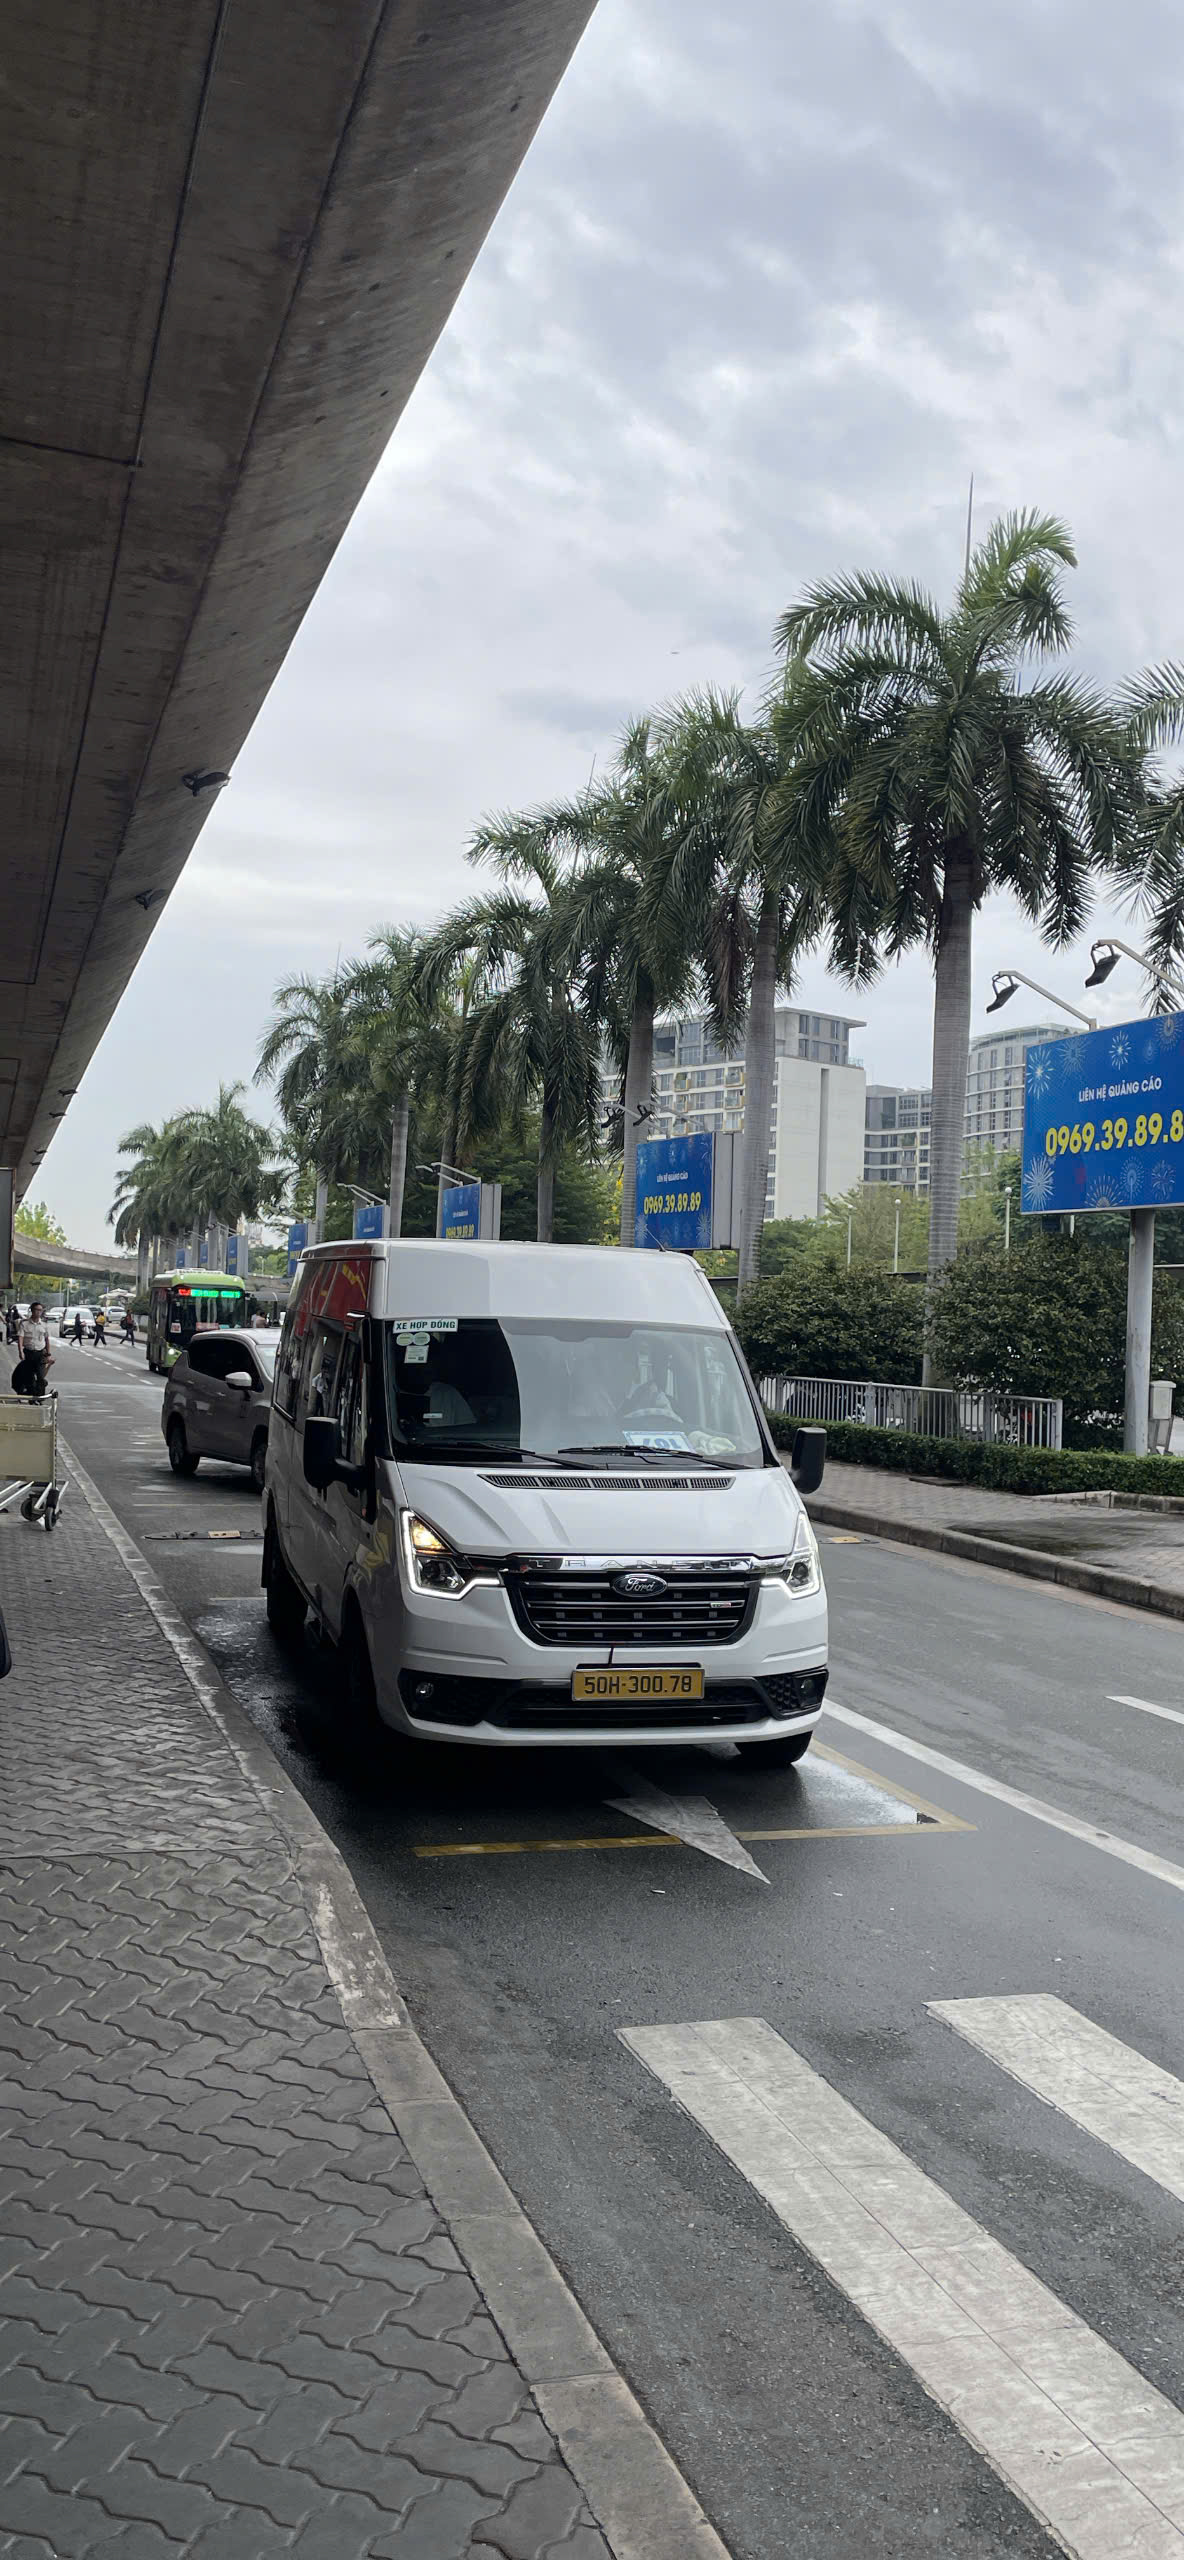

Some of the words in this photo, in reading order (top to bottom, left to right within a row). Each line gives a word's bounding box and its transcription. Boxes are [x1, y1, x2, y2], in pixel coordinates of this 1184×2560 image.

[1079, 1087, 1095, 1102] LIÊN
[1096, 1084, 1107, 1101] HỆ
[1108, 1079, 1139, 1097] QUẢNG
[1141, 1075, 1162, 1092] CÁO
[1045, 1109, 1184, 1157] 0969.39.89.8
[643, 1191, 701, 1215] 0969.39.89.89
[396, 1322, 407, 1330] XE
[410, 1320, 428, 1330] HỢP
[624, 1576, 656, 1593] Ford
[584, 1675, 692, 1695] 50H-300.78
